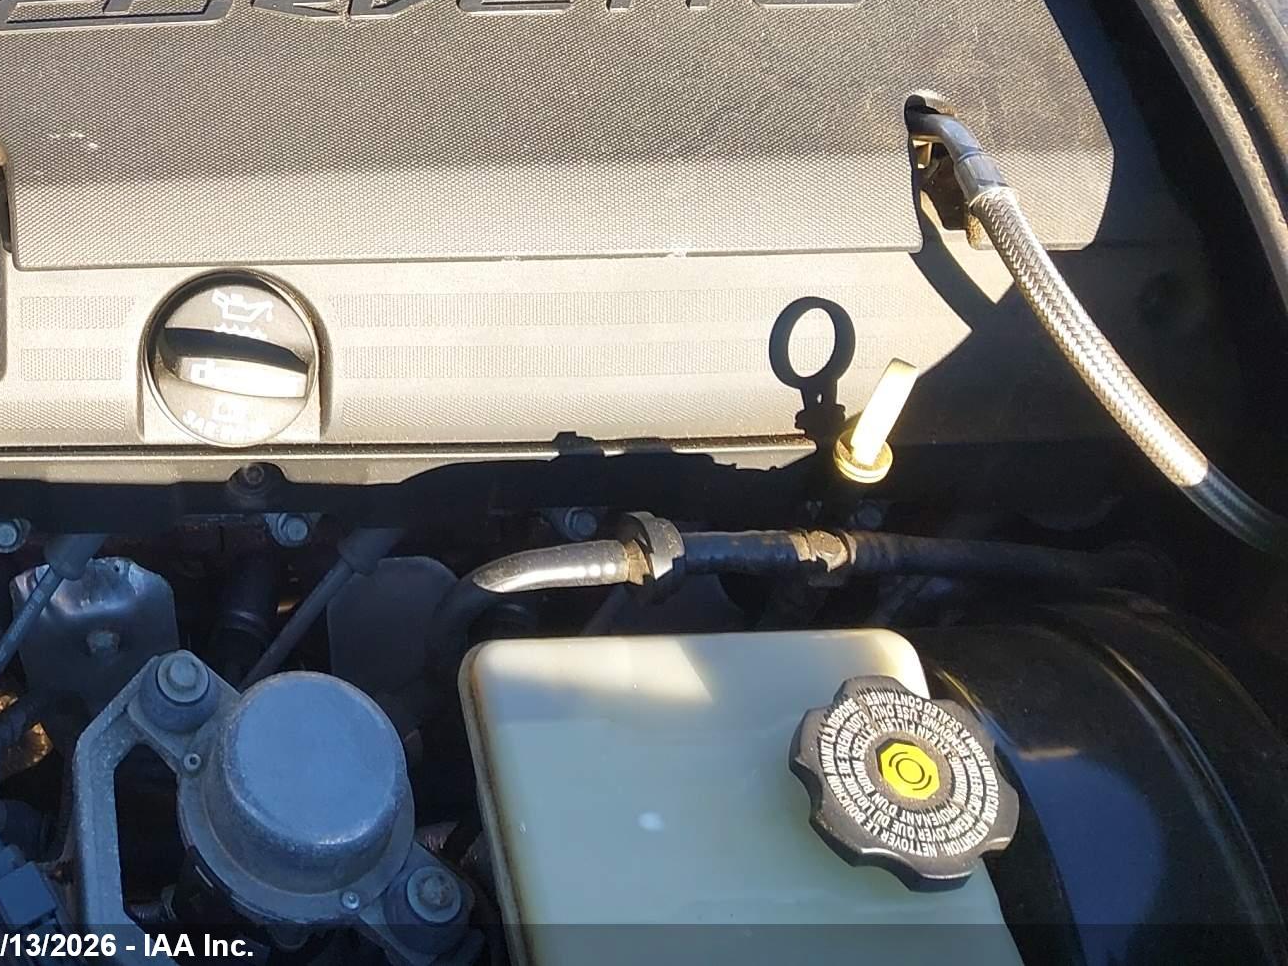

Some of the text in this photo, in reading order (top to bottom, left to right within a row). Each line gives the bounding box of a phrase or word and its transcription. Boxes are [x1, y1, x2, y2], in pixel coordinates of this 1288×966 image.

[922, 700, 964, 733] SEALED
[821, 724, 838, 743] LA
[834, 728, 854, 758] FREIN
[958, 728, 971, 740] A
[820, 740, 836, 773] AVANT
[836, 758, 851, 773] DE
[865, 703, 983, 815] CAP BEFORE REMOVING. USE ONLY
[877, 718, 967, 805] WARNING: CLEAN FILLER
[964, 735, 991, 766] FROM
[851, 759, 875, 795] BIDON
[980, 765, 998, 797] FLUID
[825, 775, 867, 826] BOUCHON
[839, 775, 876, 817] LIQUIDE
[868, 791, 898, 818] D'UN
[862, 818, 880, 836] LE
[871, 809, 891, 828] DU
[897, 799, 961, 828] PROVENANT
[877, 828, 938, 857] NETTOYER
[890, 819, 915, 839] QUE
